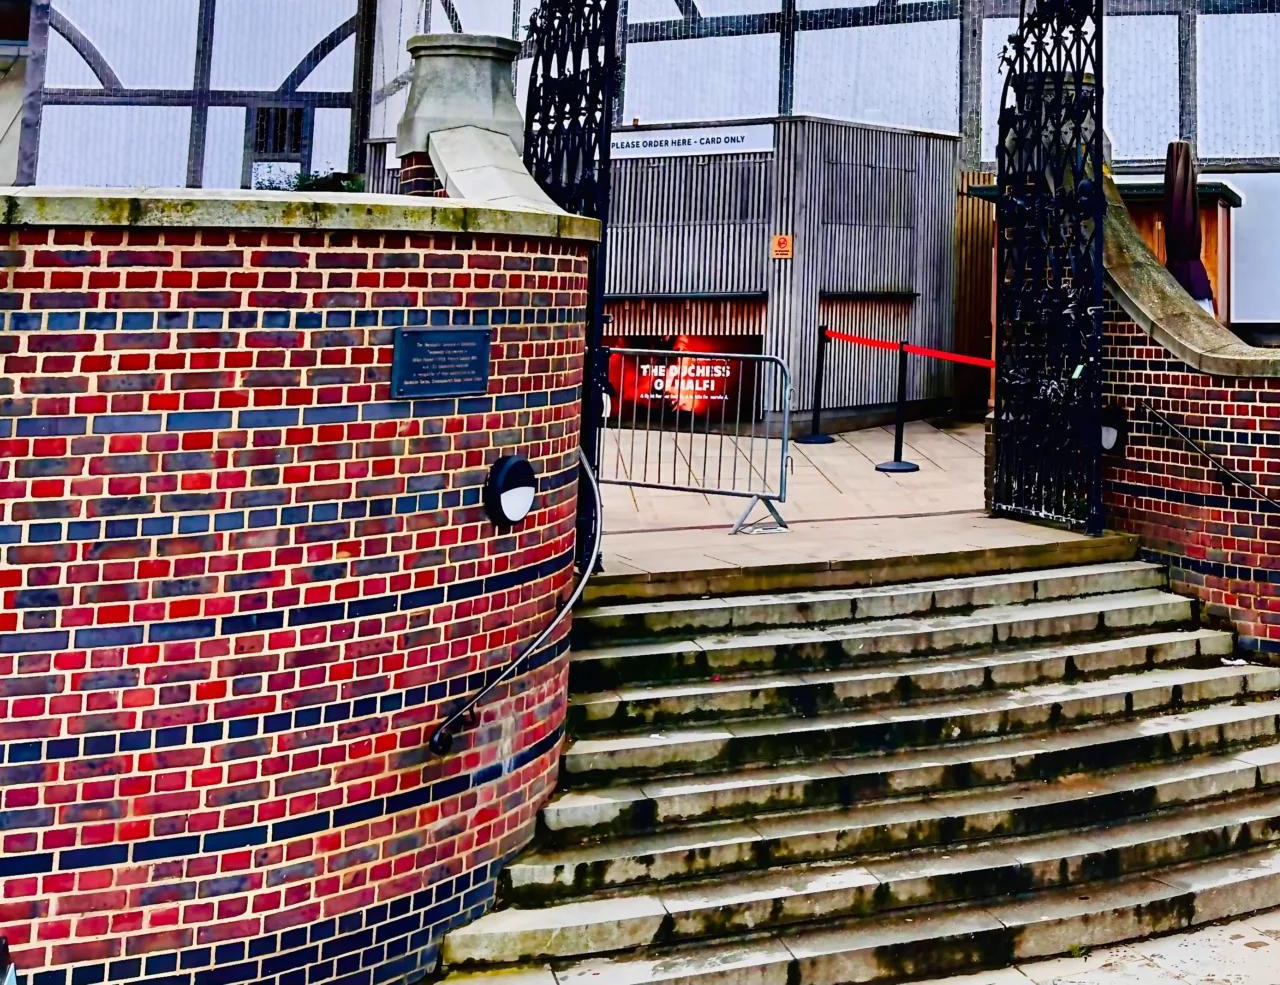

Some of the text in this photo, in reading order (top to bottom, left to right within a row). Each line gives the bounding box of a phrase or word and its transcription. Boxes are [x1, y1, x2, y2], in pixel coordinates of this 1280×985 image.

[611, 141, 640, 149] PLEASE
[642, 139, 669, 148] ORDER
[671, 138, 692, 146] HERE
[700, 137, 722, 145] CARD
[724, 135, 745, 144] ONLY
[640, 365, 666, 376] THE
